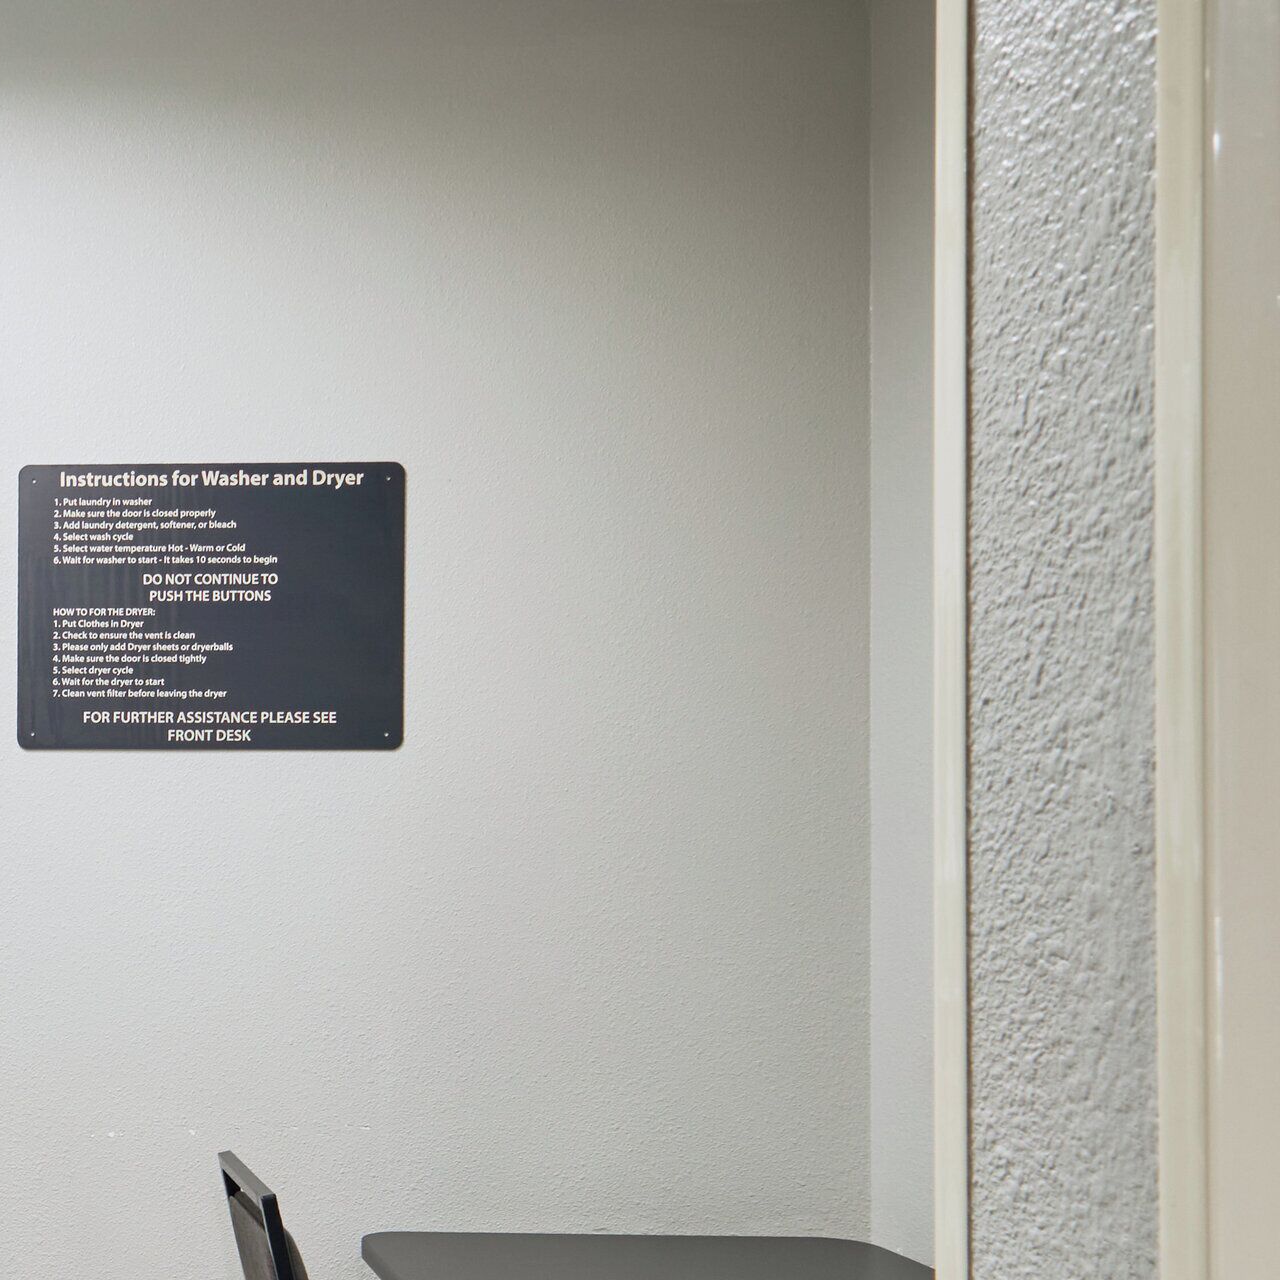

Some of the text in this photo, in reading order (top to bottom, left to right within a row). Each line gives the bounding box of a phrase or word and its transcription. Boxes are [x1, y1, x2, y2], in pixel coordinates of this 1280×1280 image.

[60, 470, 364, 489] Instructions for Washer and Dryer
[54, 497, 152, 509] 1. Put laundry in washer
[54, 510, 61, 518] 2.
[63, 509, 85, 517] Make
[107, 509, 120, 517] the
[122, 509, 142, 517] door
[144, 509, 150, 517] is
[152, 509, 178, 517] closed
[180, 509, 216, 519] properly
[54, 521, 62, 529] 3.
[63, 521, 80, 529] Add
[82, 521, 114, 531] laundry
[115, 521, 159, 531] detergent,
[160, 520, 196, 530] softener,
[209, 520, 236, 528] bleach
[53, 532, 133, 542] 4. Select wash cycle
[54, 544, 61, 552] 5.
[63, 544, 87, 552] Select
[115, 545, 166, 554] temperature
[169, 544, 183, 552] Hot
[227, 544, 245, 552] Cold
[53, 556, 61, 564] 6.
[62, 556, 81, 564] Wait
[82, 556, 95, 564] for
[96, 556, 126, 564] washer
[127, 556, 136, 564] to
[172, 555, 194, 563] takes
[208, 555, 241, 563] seconds
[253, 555, 277, 565] begin
[144, 573, 278, 585] DO NOT CONTINUE TO
[149, 590, 271, 601] PUSH THE BUTTONS
[54, 608, 155, 616] HOW TO FOR THE DRYER:
[121, 620, 144, 629] Dryer
[52, 631, 61, 639] 2.
[62, 631, 87, 639] Check
[129, 631, 143, 639] the
[165, 631, 171, 639] is
[173, 631, 195, 639] clean
[53, 643, 61, 651] 3.
[62, 643, 89, 651] Please
[90, 643, 108, 652] only
[128, 643, 151, 652] Dryer
[152, 643, 179, 651] sheets
[191, 643, 233, 652] dryerballs
[62, 654, 84, 662] Make
[106, 654, 119, 662] the
[121, 654, 141, 662] door
[151, 654, 177, 662] closed
[179, 654, 206, 664] tightly
[53, 666, 133, 676] 5. Select dryer cycle
[82, 677, 94, 685] for
[95, 677, 109, 685] the
[111, 678, 133, 687] dryer
[62, 689, 85, 697] Clean
[107, 689, 126, 697] filter
[128, 689, 155, 697] before
[157, 689, 187, 699] leaving
[189, 689, 202, 697] the
[204, 689, 227, 699] dryer
[84, 712, 336, 723] FOR FURTHER ASSISTANCE PLEASE SEE
[168, 730, 251, 741] FRONT DESK
